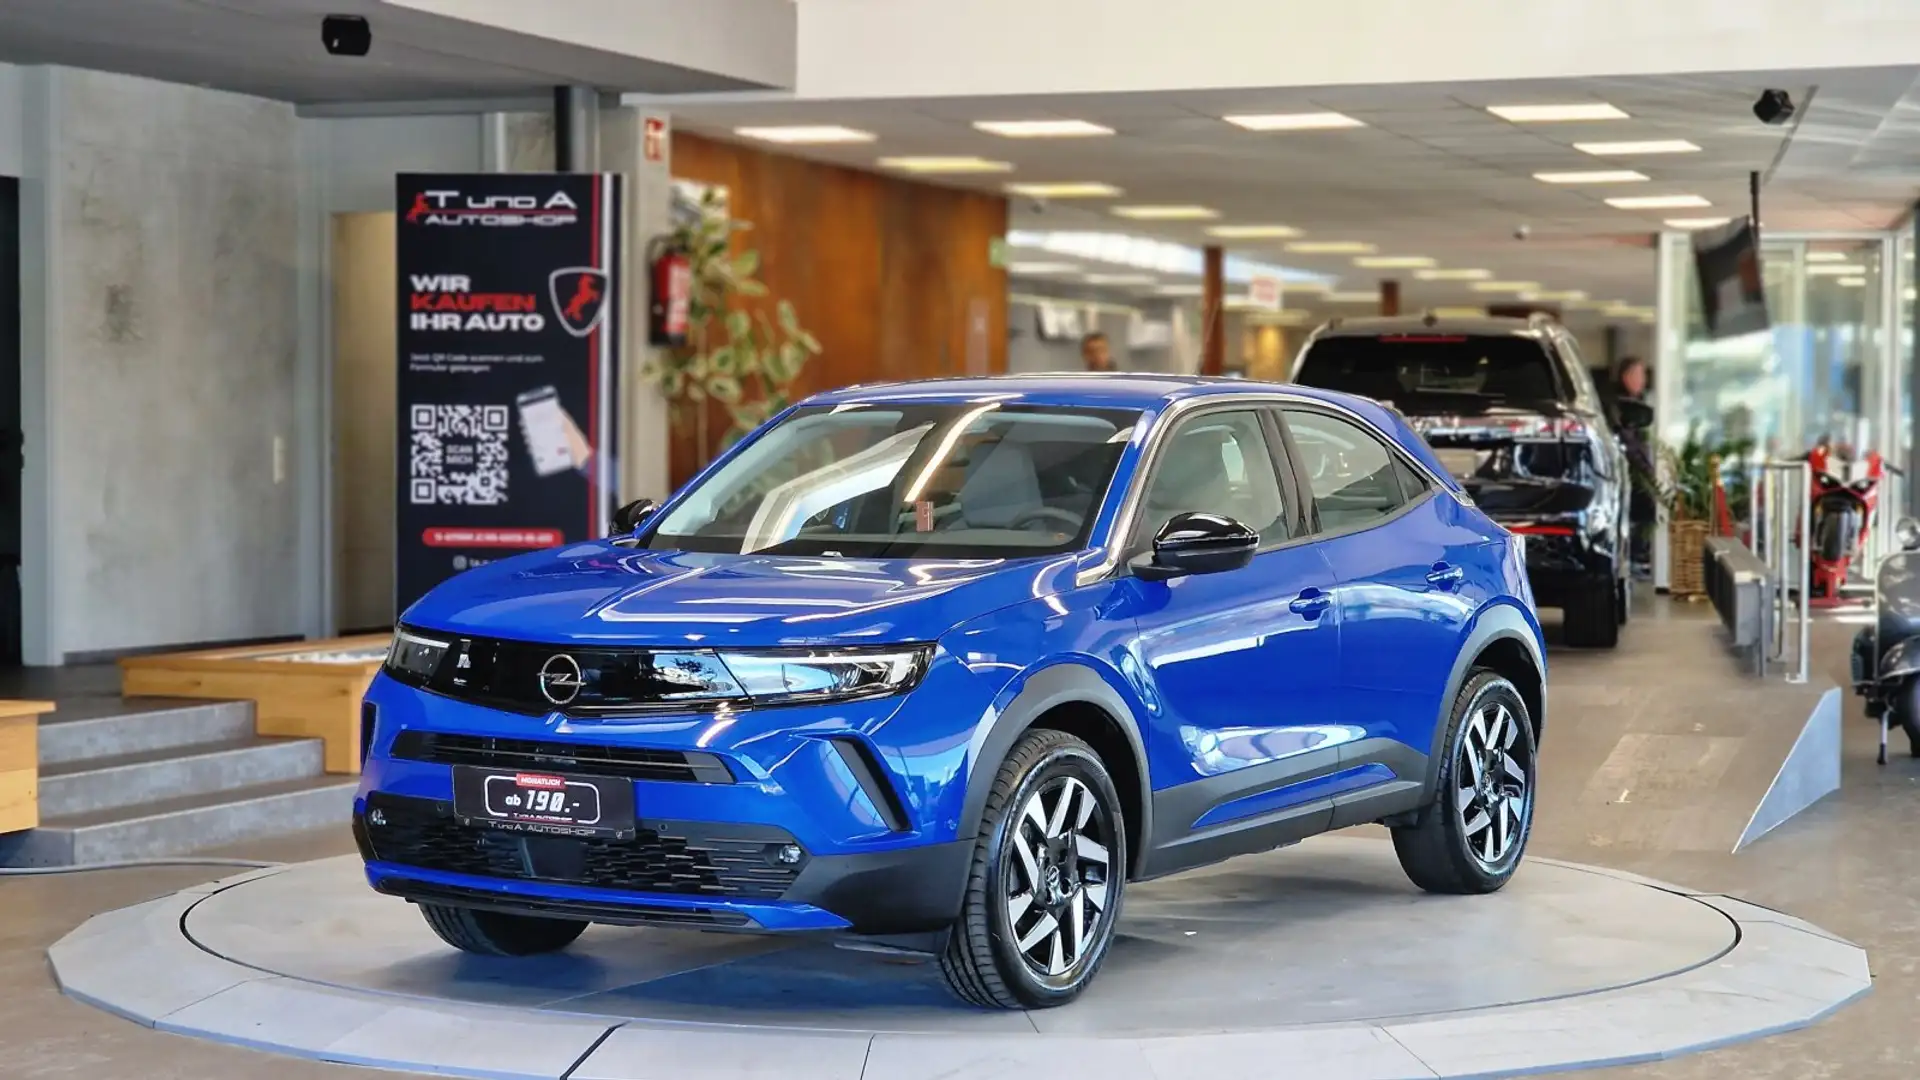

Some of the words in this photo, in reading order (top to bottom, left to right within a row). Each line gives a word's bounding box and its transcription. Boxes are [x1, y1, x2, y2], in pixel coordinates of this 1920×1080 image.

[424, 189, 460, 208] T
[544, 189, 578, 209] A
[424, 214, 578, 226] AUTOSHOP
[410, 274, 471, 292] WIR
[410, 293, 537, 312] KAUFEN
[410, 313, 462, 331] IHR
[464, 313, 545, 332] AUTO
[505, 794, 521, 806] ab
[527, 825, 595, 836] AUTOSHOP
